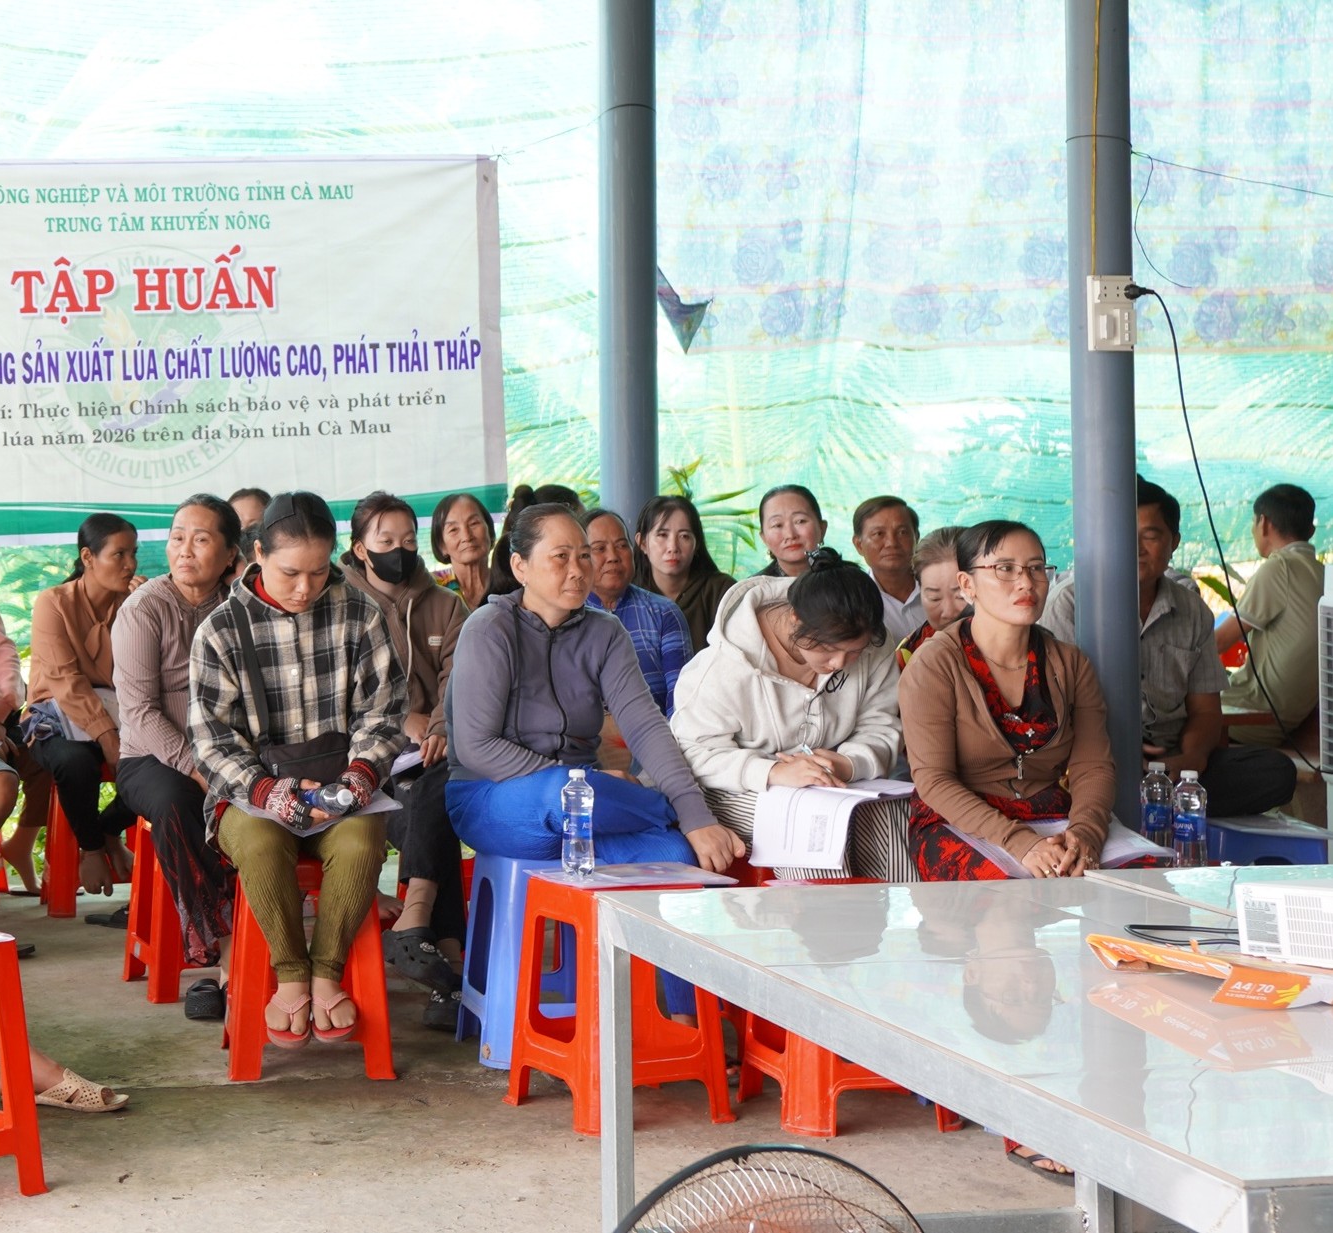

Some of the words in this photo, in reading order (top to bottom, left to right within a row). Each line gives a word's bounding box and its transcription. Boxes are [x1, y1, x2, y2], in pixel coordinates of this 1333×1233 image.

[36, 183, 100, 206] NGHIỆP
[106, 183, 129, 203] VÀ
[134, 183, 166, 202] MÔI
[172, 182, 240, 202] TRƯỜNG
[246, 180, 285, 201] TỈNH
[291, 181, 314, 200] CÀ
[319, 185, 354, 200] MAU
[45, 217, 102, 233] TRUNG
[108, 212, 144, 232] TÂM
[151, 208, 219, 231] KHUYẾN
[225, 211, 271, 230] NÔNG
[10, 256, 116, 325] TẬP
[132, 244, 277, 312] HUẤN
[21, 339, 60, 384] SẢN
[66, 337, 115, 383] XUẤT
[121, 340, 159, 381] LÚA
[164, 334, 213, 380] CHẤT
[220, 340, 281, 384] LƯỢNG
[286, 343, 327, 382] CAO,
[333, 334, 380, 375] PHÁT
[386, 329, 429, 373] THẢI
[434, 326, 482, 371] THẤP
[19, 402, 70, 422] Thực
[77, 399, 122, 420] hiện
[129, 398, 188, 416] Chính
[195, 397, 241, 414] sách
[247, 394, 281, 412] bảo
[288, 395, 310, 413] vệ
[317, 393, 340, 410] và
[347, 391, 391, 412] phát
[398, 387, 447, 407] triển
[3, 431, 34, 447] lúa
[42, 430, 85, 446] năm
[92, 427, 136, 444] 2026
[142, 426, 185, 442] trên
[191, 425, 222, 443] địa
[229, 423, 265, 439] bàn
[272, 420, 311, 438] tỉnh
[318, 420, 343, 437] Cà
[350, 419, 393, 435] Mau
[1231, 981, 1251, 992] A4
[1255, 983, 1275, 993] 70
